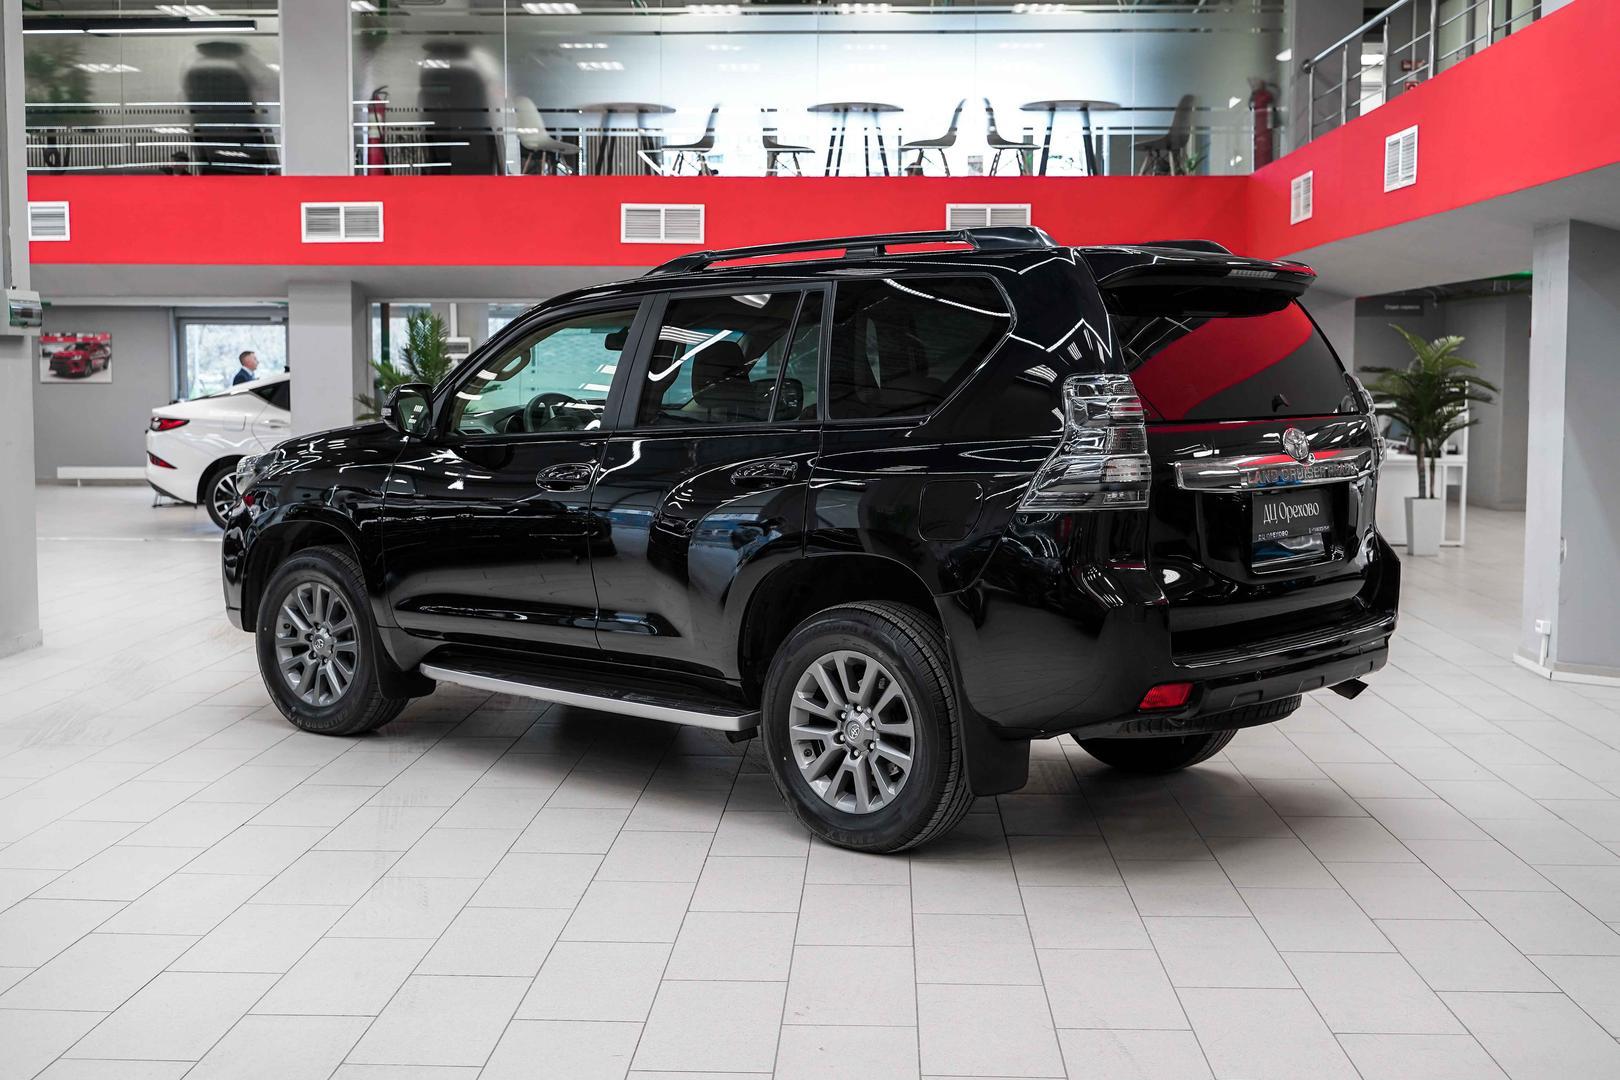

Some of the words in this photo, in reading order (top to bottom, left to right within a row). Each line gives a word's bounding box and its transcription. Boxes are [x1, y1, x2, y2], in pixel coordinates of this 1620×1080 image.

[1247, 469, 1279, 483] LAND
[1281, 463, 1327, 481] CRUISER
[1263, 503, 1278, 525] ДЦ
[1278, 501, 1320, 524] Орехово
